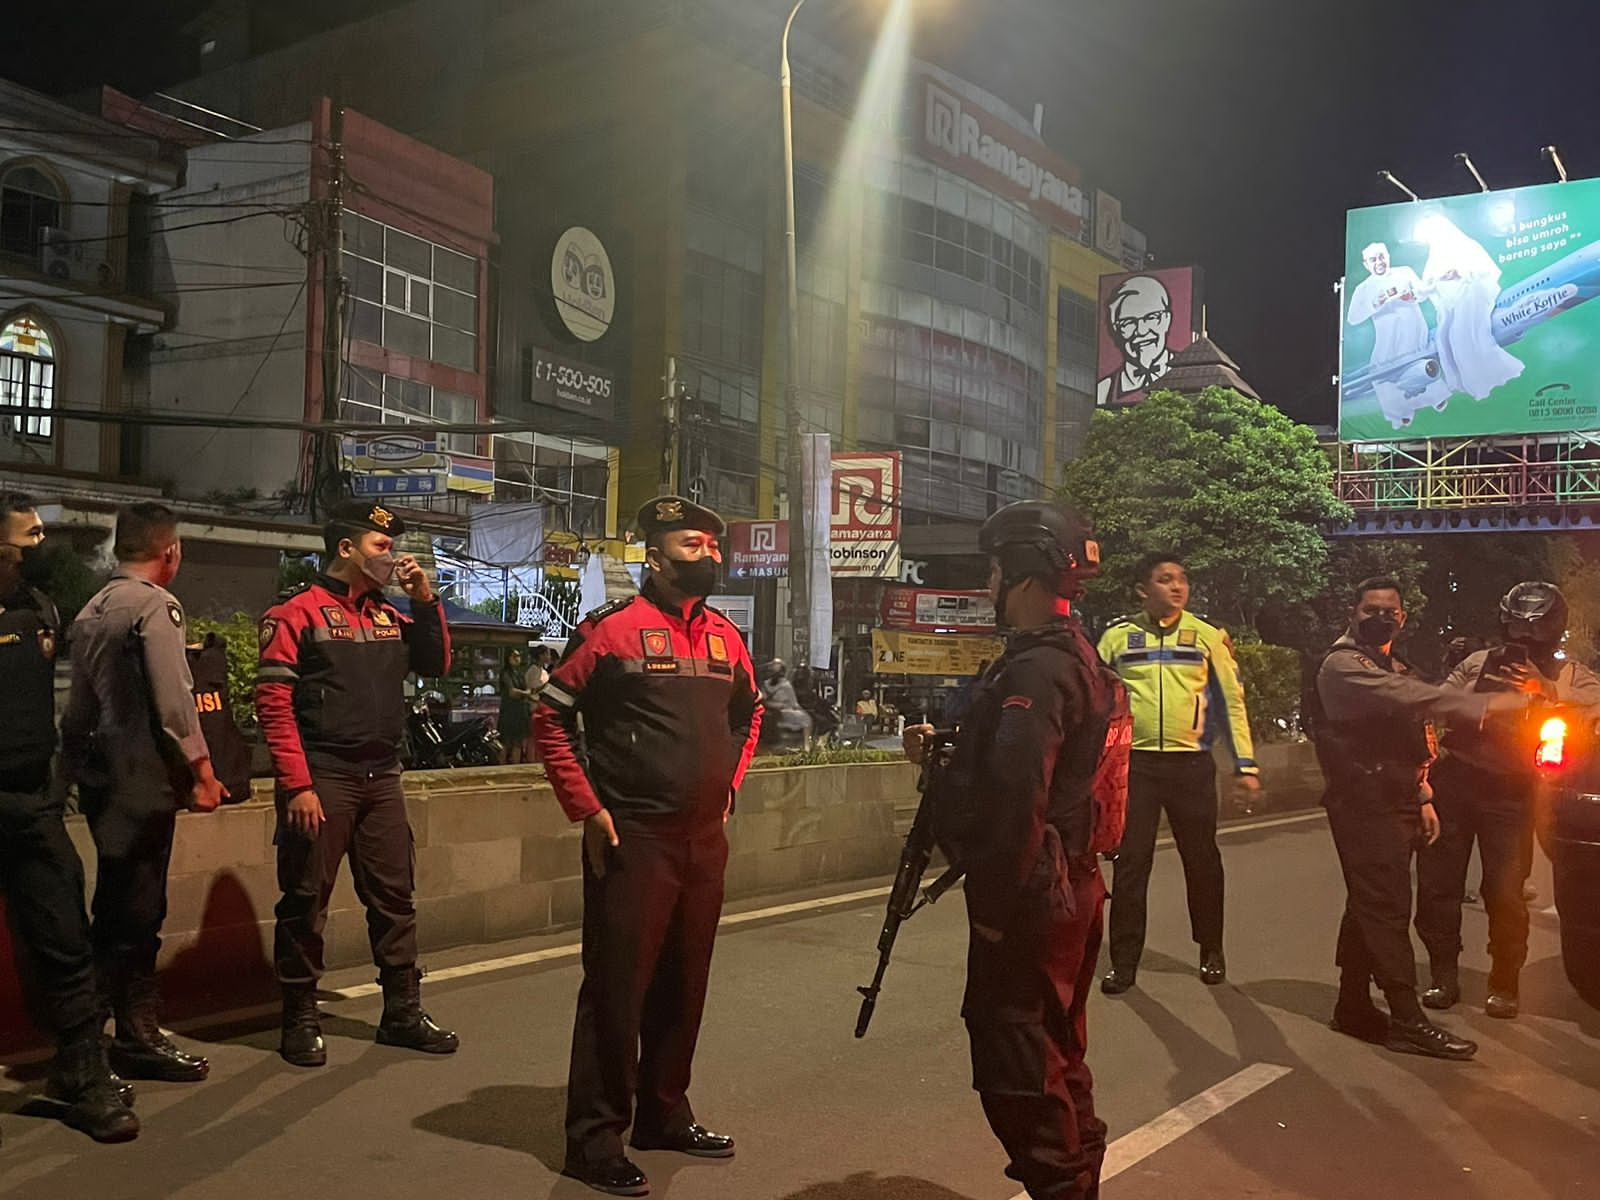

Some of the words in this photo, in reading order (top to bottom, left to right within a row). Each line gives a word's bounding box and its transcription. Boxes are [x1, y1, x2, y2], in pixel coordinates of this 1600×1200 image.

[960, 112, 1083, 217] Ramayana
[1519, 211, 1567, 231] bungkus
[1506, 235, 1530, 248] bisa
[1532, 223, 1569, 240] umroh
[1498, 246, 1538, 263] bareng
[1540, 238, 1567, 252] saya
[1501, 307, 1532, 327] White
[1534, 289, 1569, 311] Koffie
[545, 363, 612, 398] 1-500-505
[1528, 399, 1545, 407] Call
[1547, 397, 1577, 406] Center
[831, 529, 892, 540] amayana
[749, 567, 789, 577] MASUK
[895, 559, 928, 585] FC
[195, 691, 222, 712] ISI
